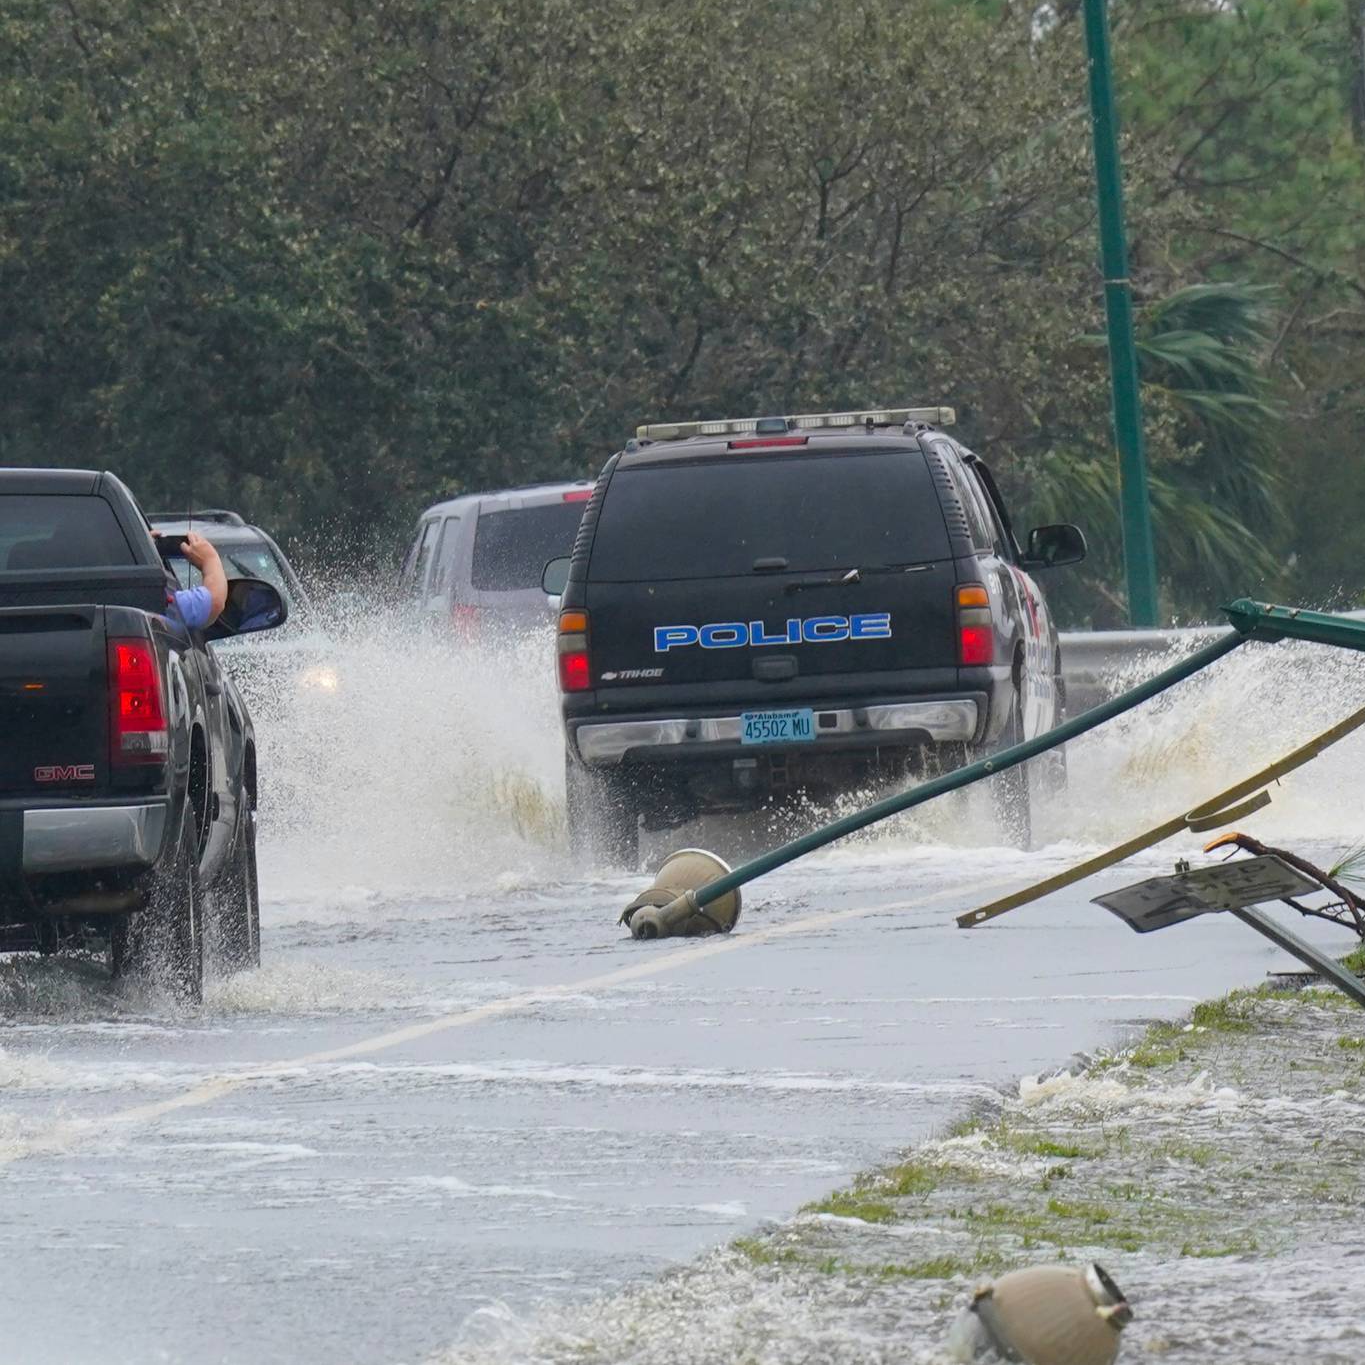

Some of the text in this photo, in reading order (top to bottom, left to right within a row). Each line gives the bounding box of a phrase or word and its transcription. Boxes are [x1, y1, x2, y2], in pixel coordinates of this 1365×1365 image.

[654, 612, 892, 653] POLICE
[619, 667, 664, 680] TAHOE
[745, 716, 810, 739] 45502 MU
[34, 764, 95, 782] GMC
